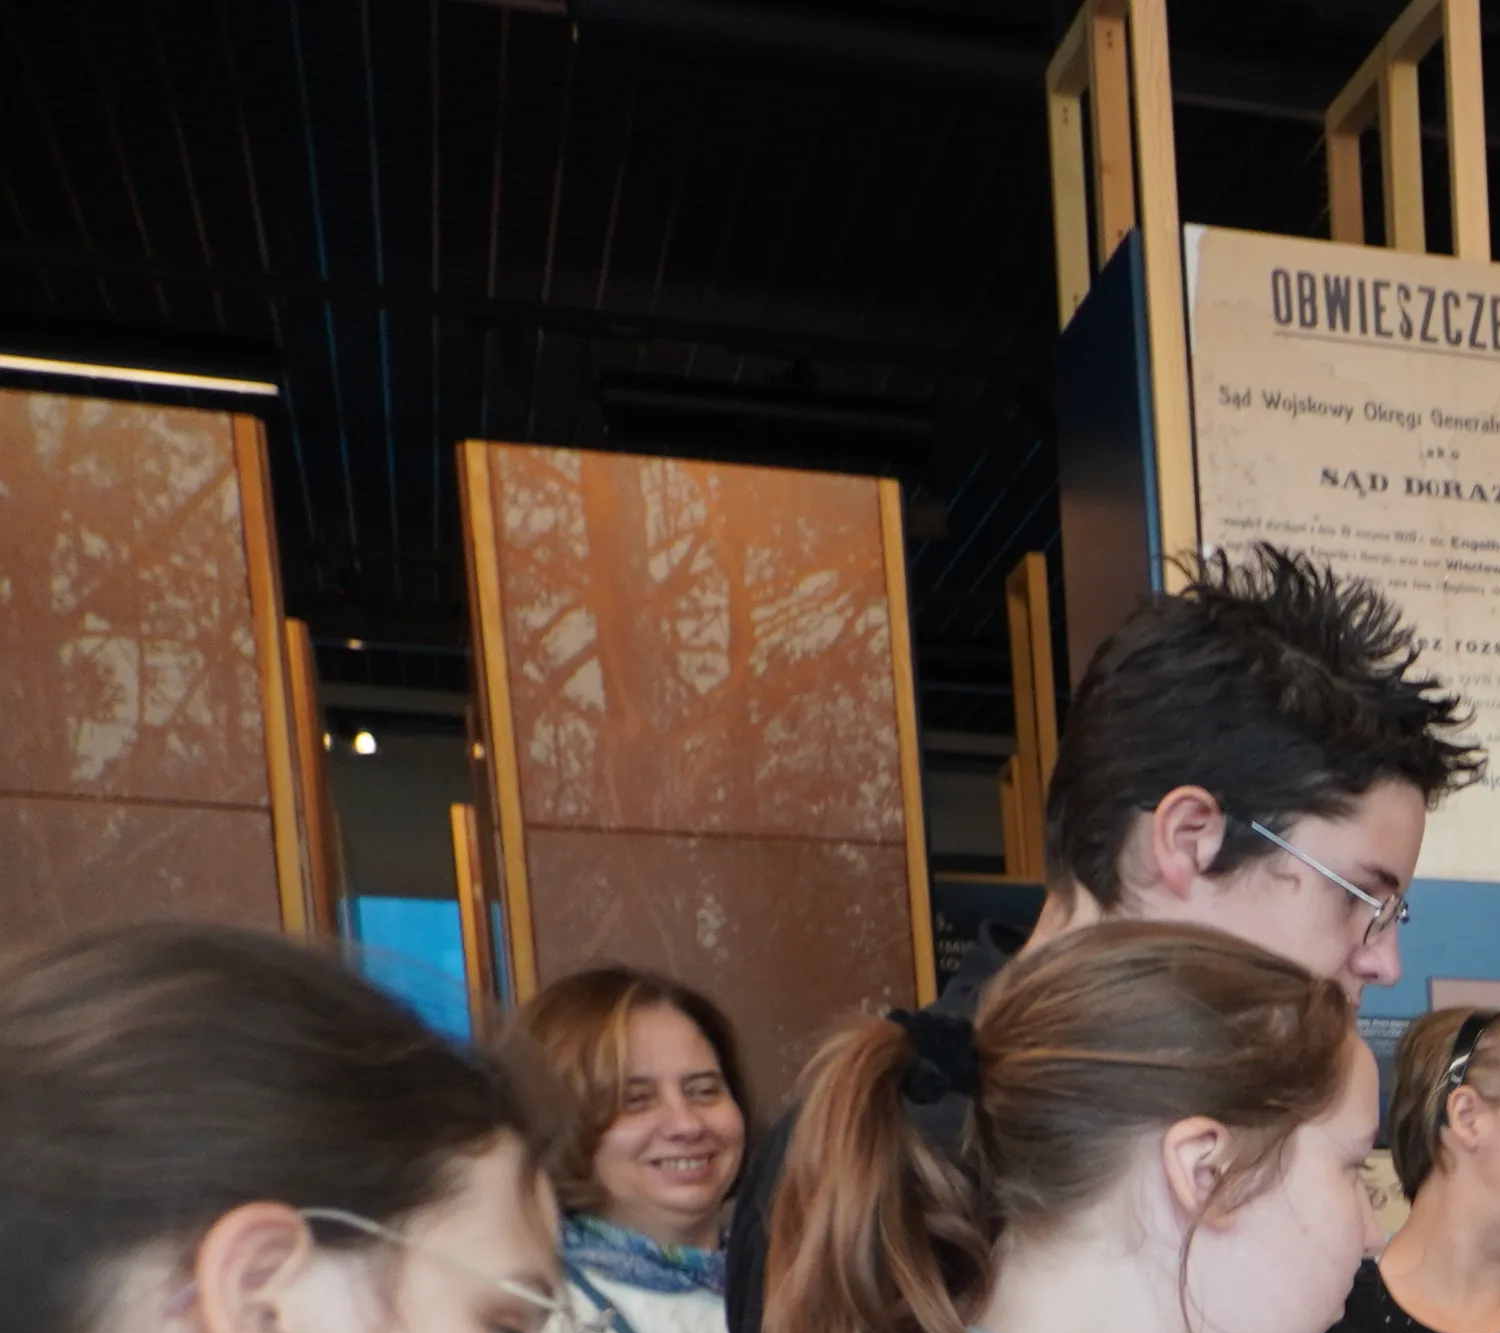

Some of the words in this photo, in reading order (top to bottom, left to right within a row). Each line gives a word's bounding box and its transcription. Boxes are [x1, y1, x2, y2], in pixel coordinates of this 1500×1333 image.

[1218, 384, 1252, 410] Sąd
[1261, 389, 1353, 423] Wojskowy
[1319, 466, 1389, 500] SĄD
